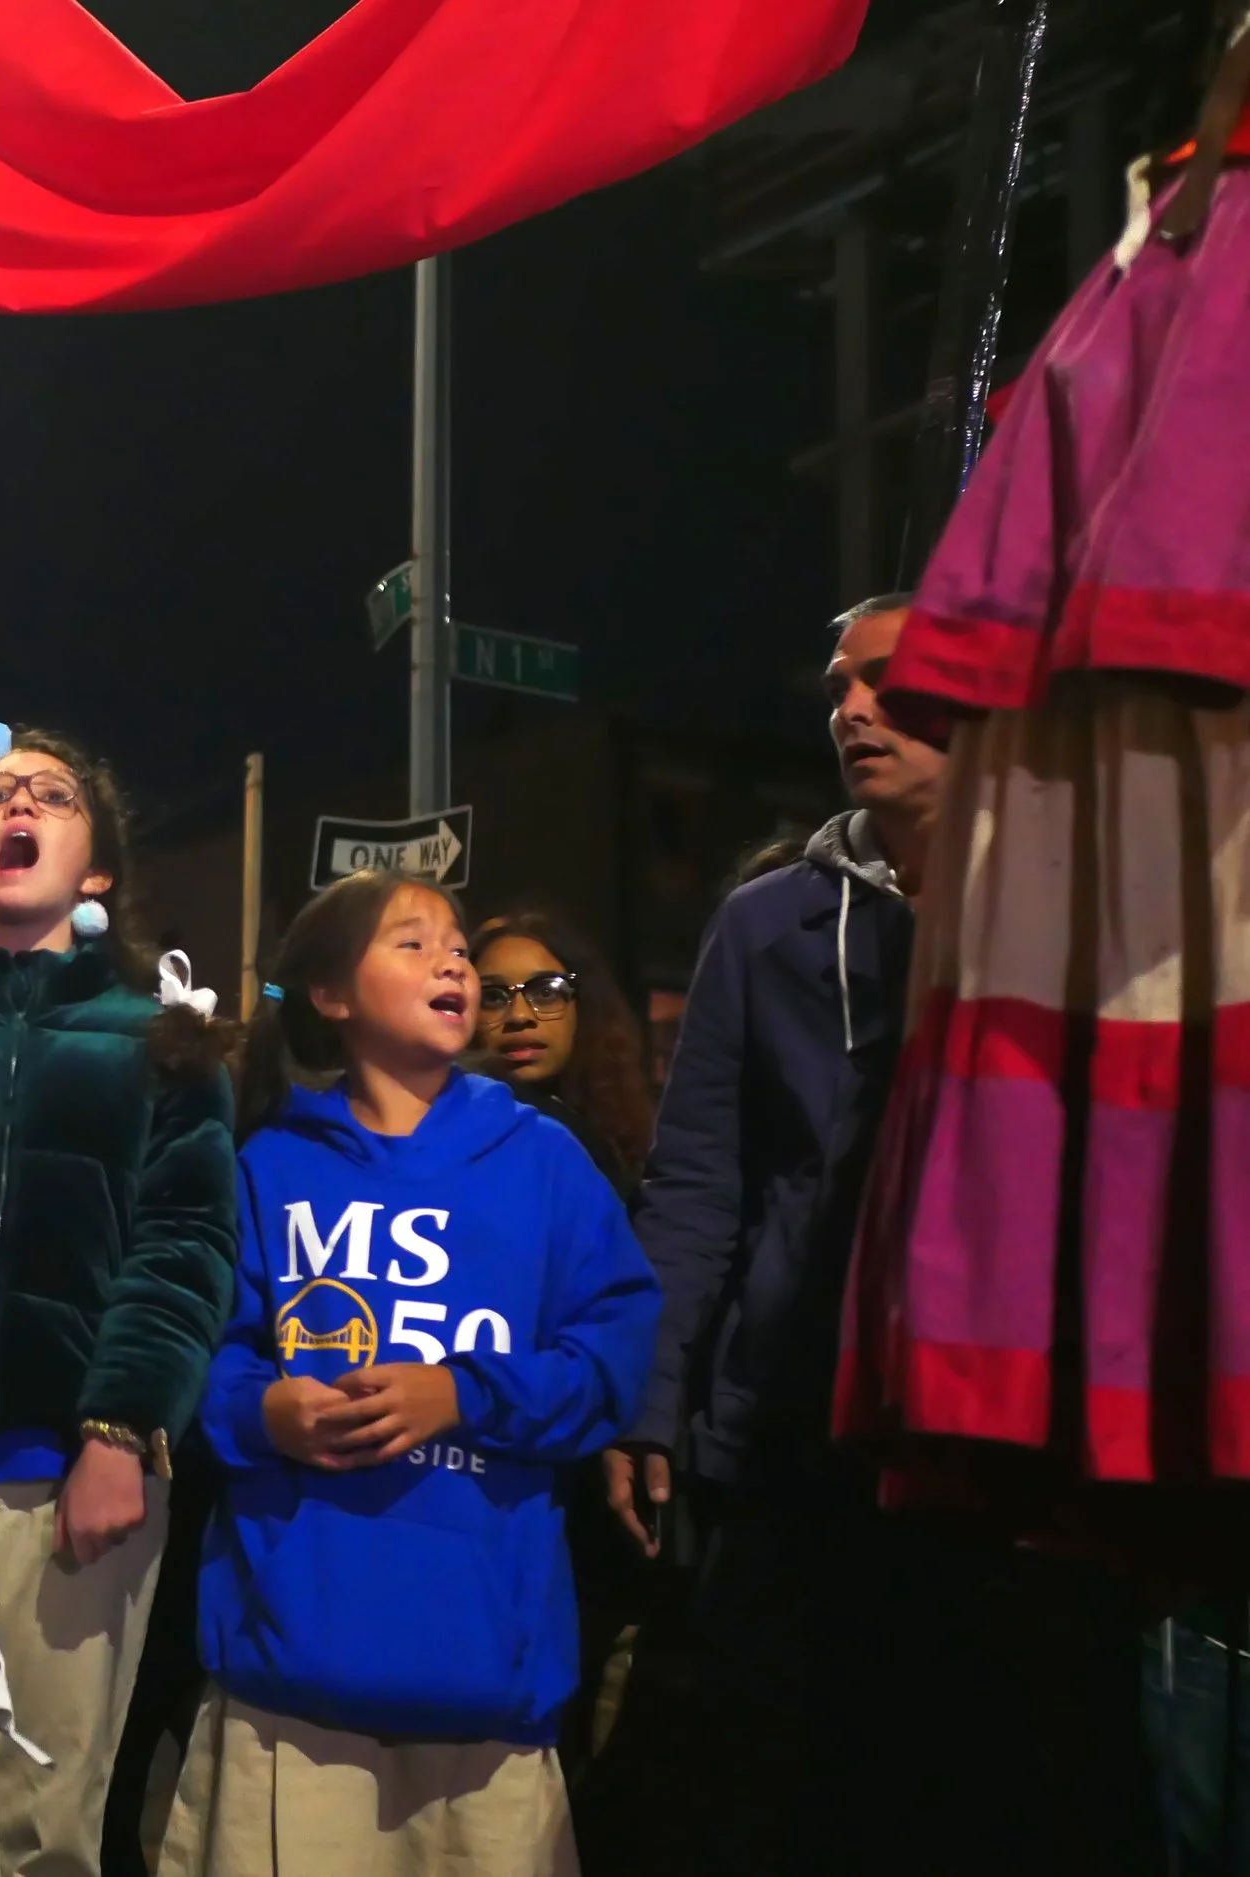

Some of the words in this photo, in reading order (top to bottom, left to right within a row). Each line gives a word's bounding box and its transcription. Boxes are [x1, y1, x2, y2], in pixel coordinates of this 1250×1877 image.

[475, 635, 496, 677] N
[349, 845, 406, 870] ONE
[420, 835, 453, 868] WAY
[279, 1200, 450, 1287] MS
